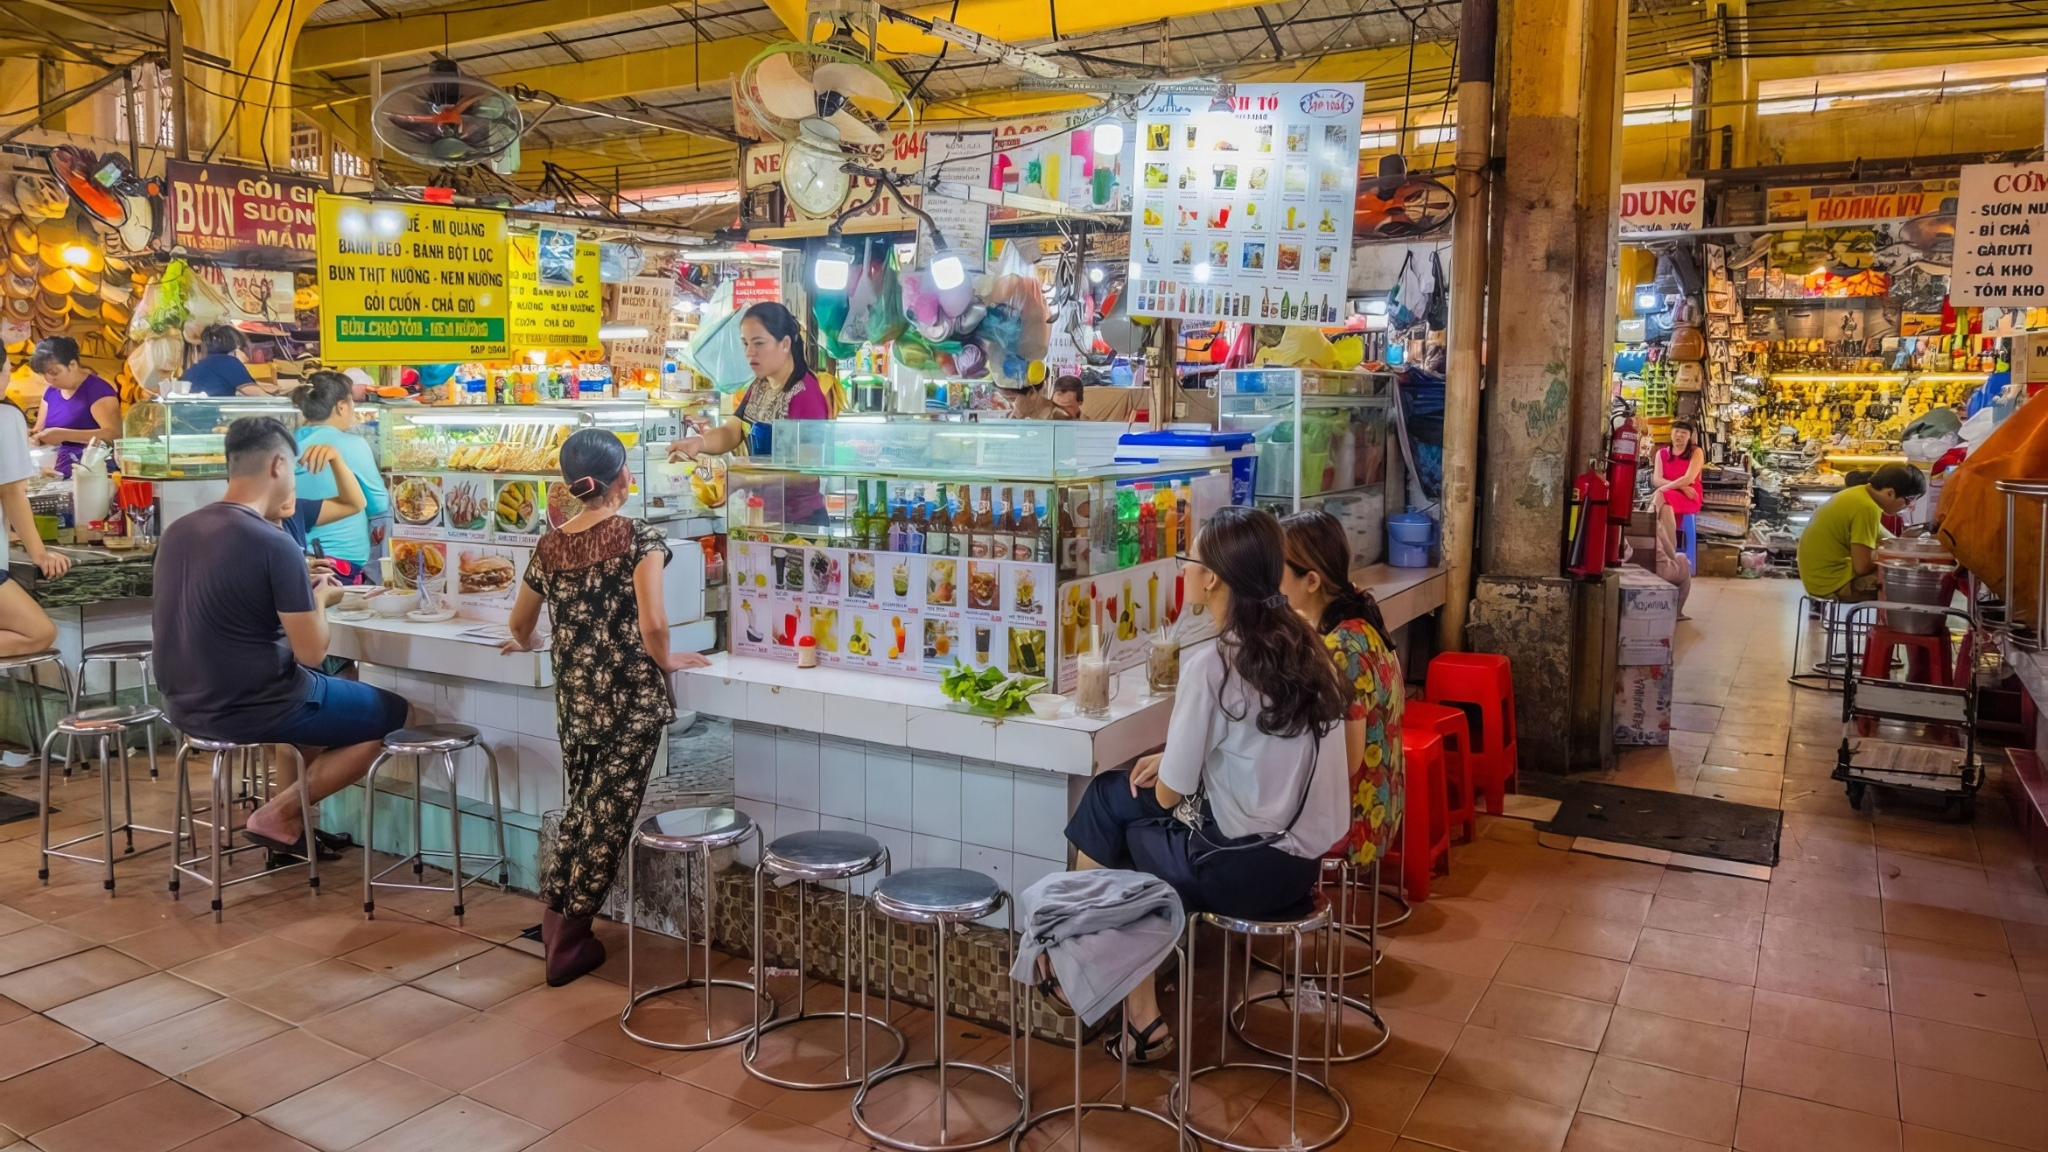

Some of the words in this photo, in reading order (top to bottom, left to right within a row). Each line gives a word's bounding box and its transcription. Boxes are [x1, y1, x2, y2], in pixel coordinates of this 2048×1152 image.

[173, 169, 235, 237] BÚN
[1620, 189, 1697, 217] DUNG
[243, 202, 316, 226] SUÔN
[2000, 219, 2030, 236] CHẢ
[1975, 262, 1995, 276] CÁ
[2001, 264, 2033, 276] KHO
[441, 271, 465, 287] NEM
[2012, 285, 2045, 297] KHO
